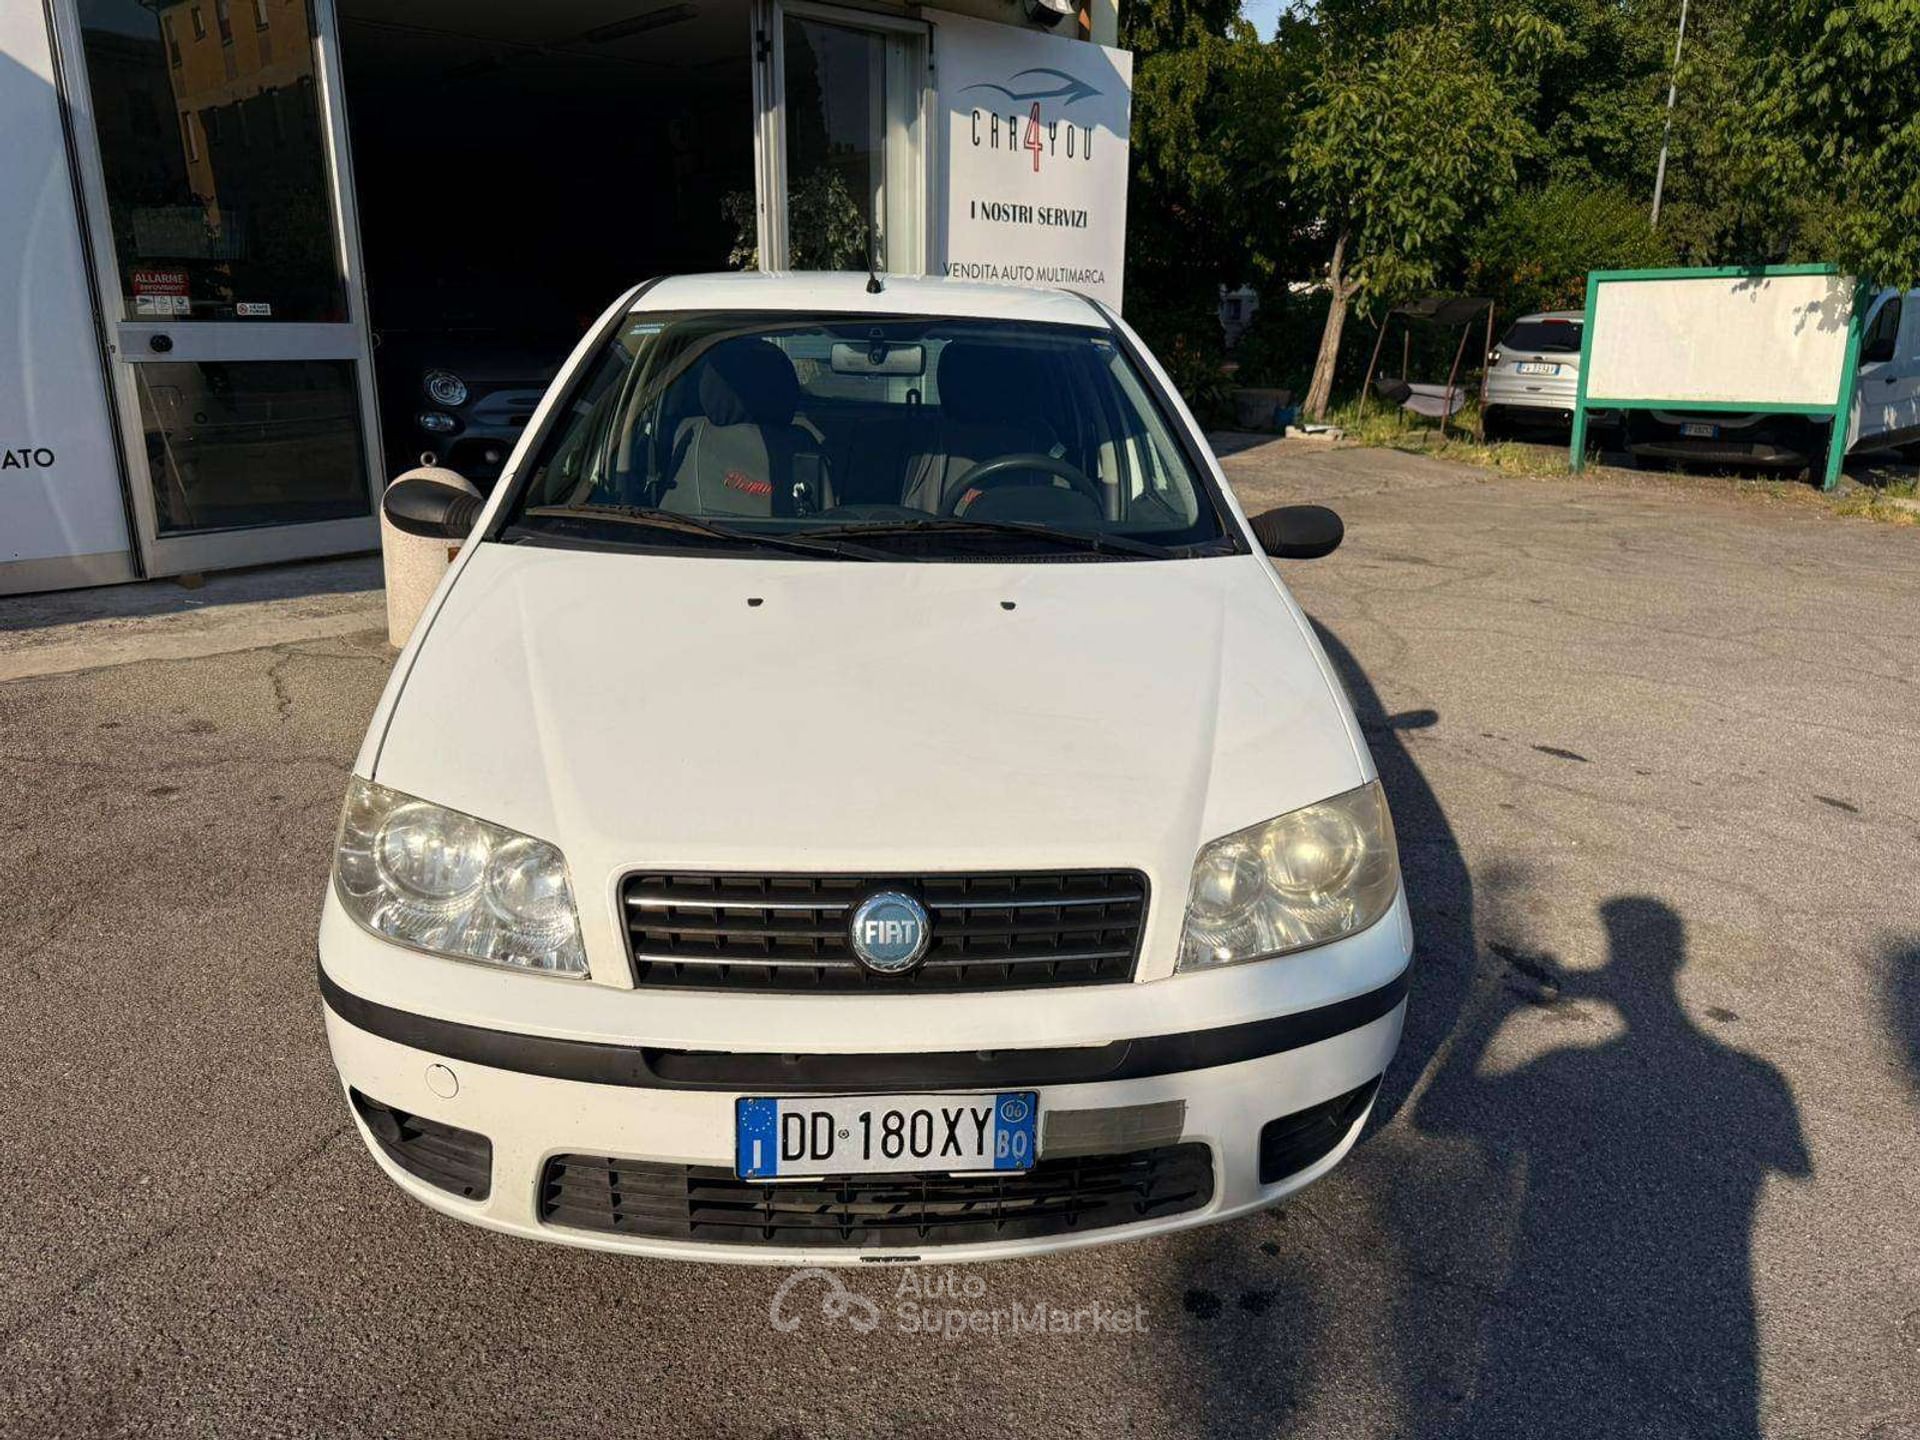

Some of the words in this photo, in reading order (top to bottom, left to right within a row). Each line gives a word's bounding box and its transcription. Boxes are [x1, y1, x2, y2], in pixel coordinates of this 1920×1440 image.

[970, 200, 976, 220] I
[981, 202, 1033, 224] NOSTRI
[1037, 207, 1088, 229] SERVIZI
[135, 273, 185, 284] ALLARME
[943, 262, 999, 281] VENDITA
[1001, 266, 1034, 281] AUTO
[1036, 268, 1105, 284] MULTIMARCA
[865, 920, 916, 945] FIAT
[1005, 1104, 1022, 1117] 06
[859, 1107, 993, 1160] 180XY
[996, 1129, 1028, 1159] BO
